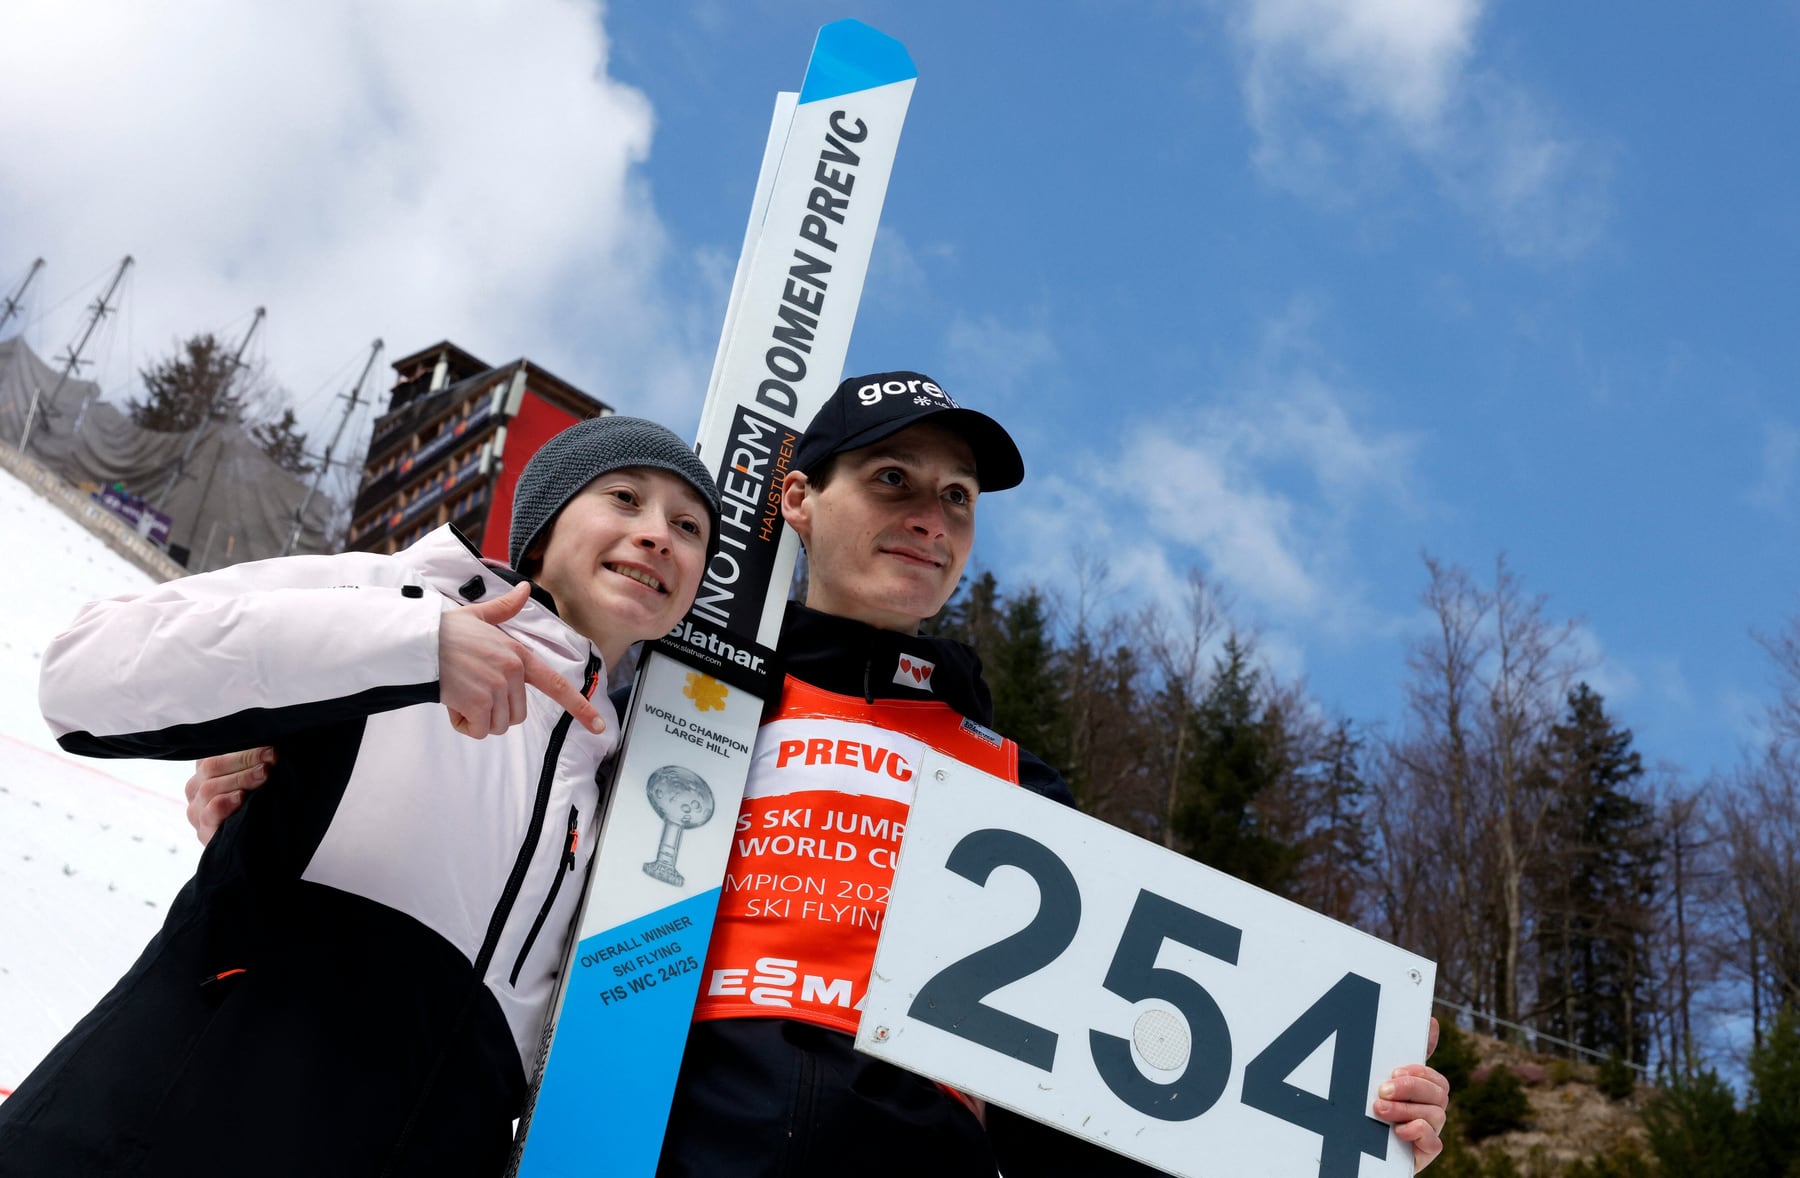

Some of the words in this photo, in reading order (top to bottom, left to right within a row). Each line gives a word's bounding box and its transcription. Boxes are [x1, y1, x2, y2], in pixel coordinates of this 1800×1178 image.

[754, 249, 832, 420] DOMEN
[798, 110, 868, 254] PREVC
[858, 380, 959, 409] gore
[758, 432, 797, 542] HAUSTÜREN
[660, 638, 722, 667] www.slatnar.com
[644, 703, 687, 728] WORLD
[689, 721, 749, 754] CHAMPION
[664, 723, 704, 747] LARGE
[706, 738, 730, 758] HILL
[776, 738, 913, 782] PREVC
[763, 808, 812, 829] SKI
[820, 810, 906, 842] JUMP
[738, 835, 857, 862] WORLD
[745, 898, 790, 918] SKI
[802, 901, 882, 931] FLYIN
[580, 937, 642, 968] OVERALL
[640, 916, 693, 943] WINNER
[612, 961, 636, 977] SKI
[635, 942, 682, 968] FLYING
[599, 985, 628, 1006] FIS
[627, 973, 657, 994] WC
[657, 955, 699, 983] 24/25
[906, 827, 1391, 1178] 254
